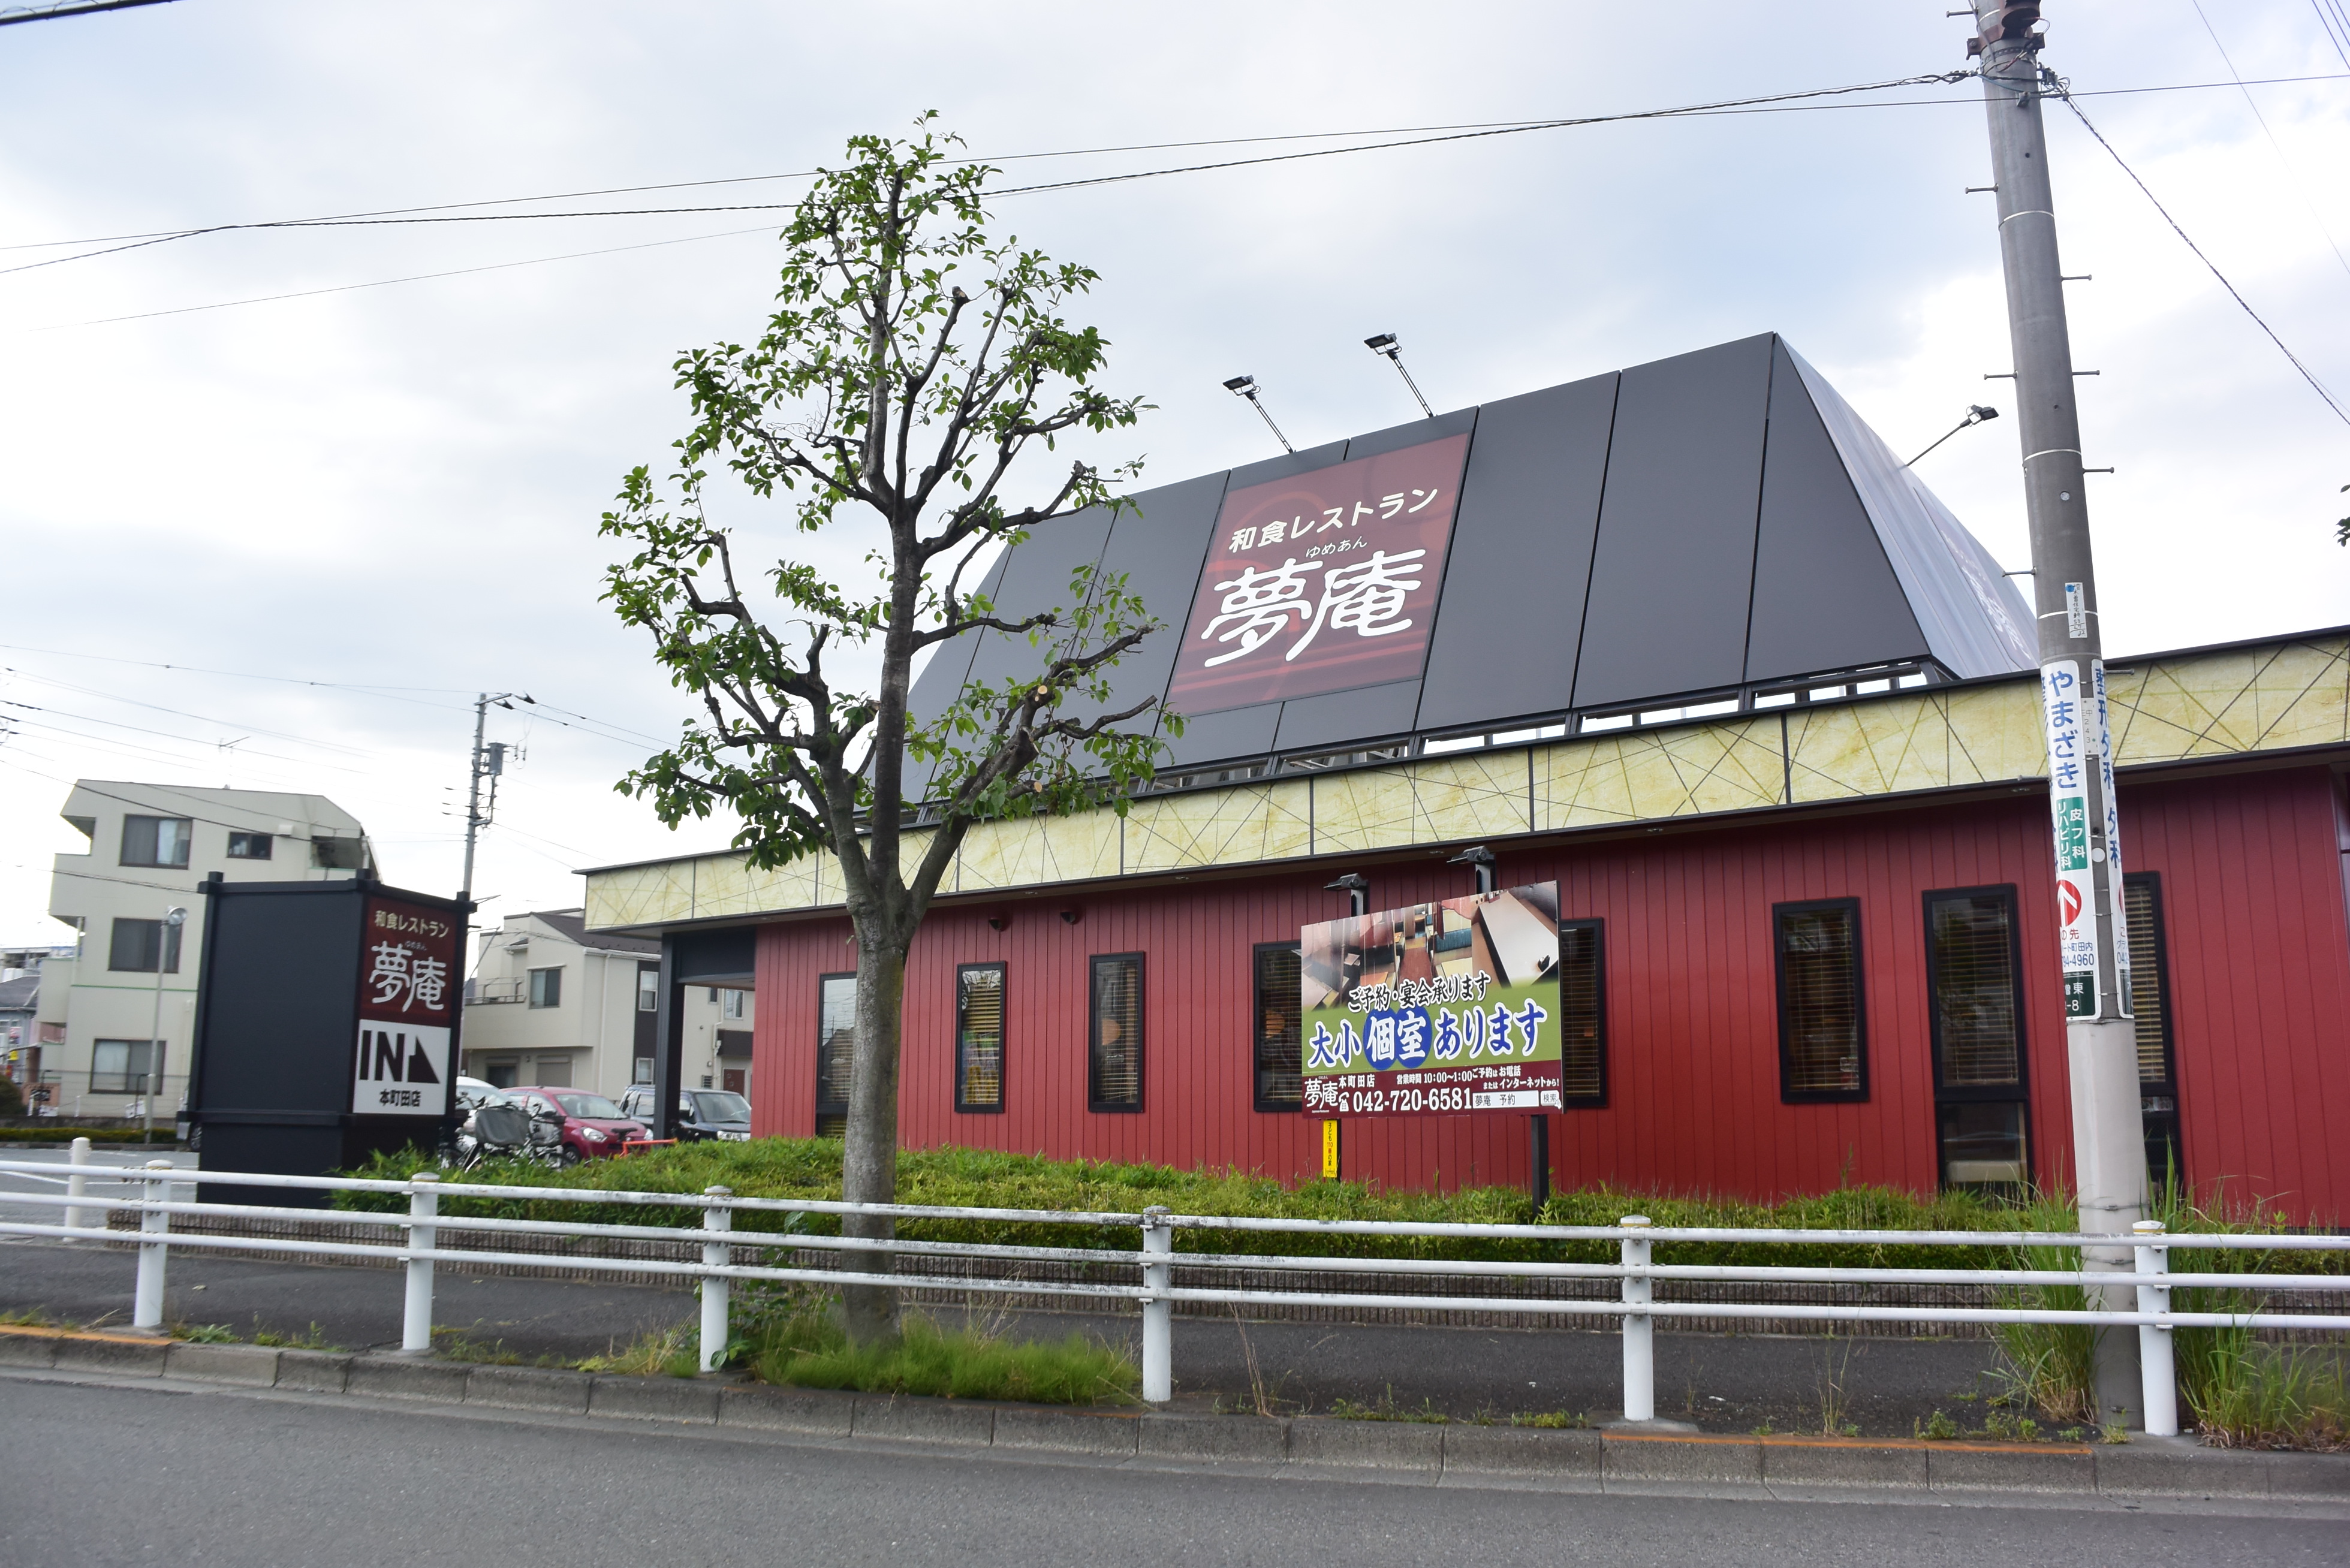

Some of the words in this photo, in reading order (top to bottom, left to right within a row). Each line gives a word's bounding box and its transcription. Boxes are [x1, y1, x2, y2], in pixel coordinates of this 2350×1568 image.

[1229, 489, 1438, 553] 和食レストラン
[1306, 536, 1367, 559] ゆめあん
[1201, 549, 1426, 668] 夢庵
[2048, 670, 2079, 789] やまざき
[2057, 801, 2072, 869] リハビリ科
[2069, 808, 2086, 858] 皮フ科
[374, 910, 449, 938] 和食レストラン
[2062, 942, 2093, 952] ート町田内
[2062, 953, 2095, 967] 94-4960
[369, 940, 447, 1012] 夢庵
[1348, 970, 1491, 1014] ご予約・宴会承ります
[2065, 999, 2080, 1011] -8
[359, 1030, 405, 1082] IN
[1304, 1078, 1338, 1109] 夢庵
[1339, 1074, 1375, 1089] 本町田店
[379, 1088, 421, 1108] 本町田店
[1353, 1087, 1472, 1112] 042-720-6581
[1475, 1094, 1492, 1106] 夢庵
[1499, 1093, 1516, 1106] 予約
[1543, 1093, 1557, 1103] 検索
